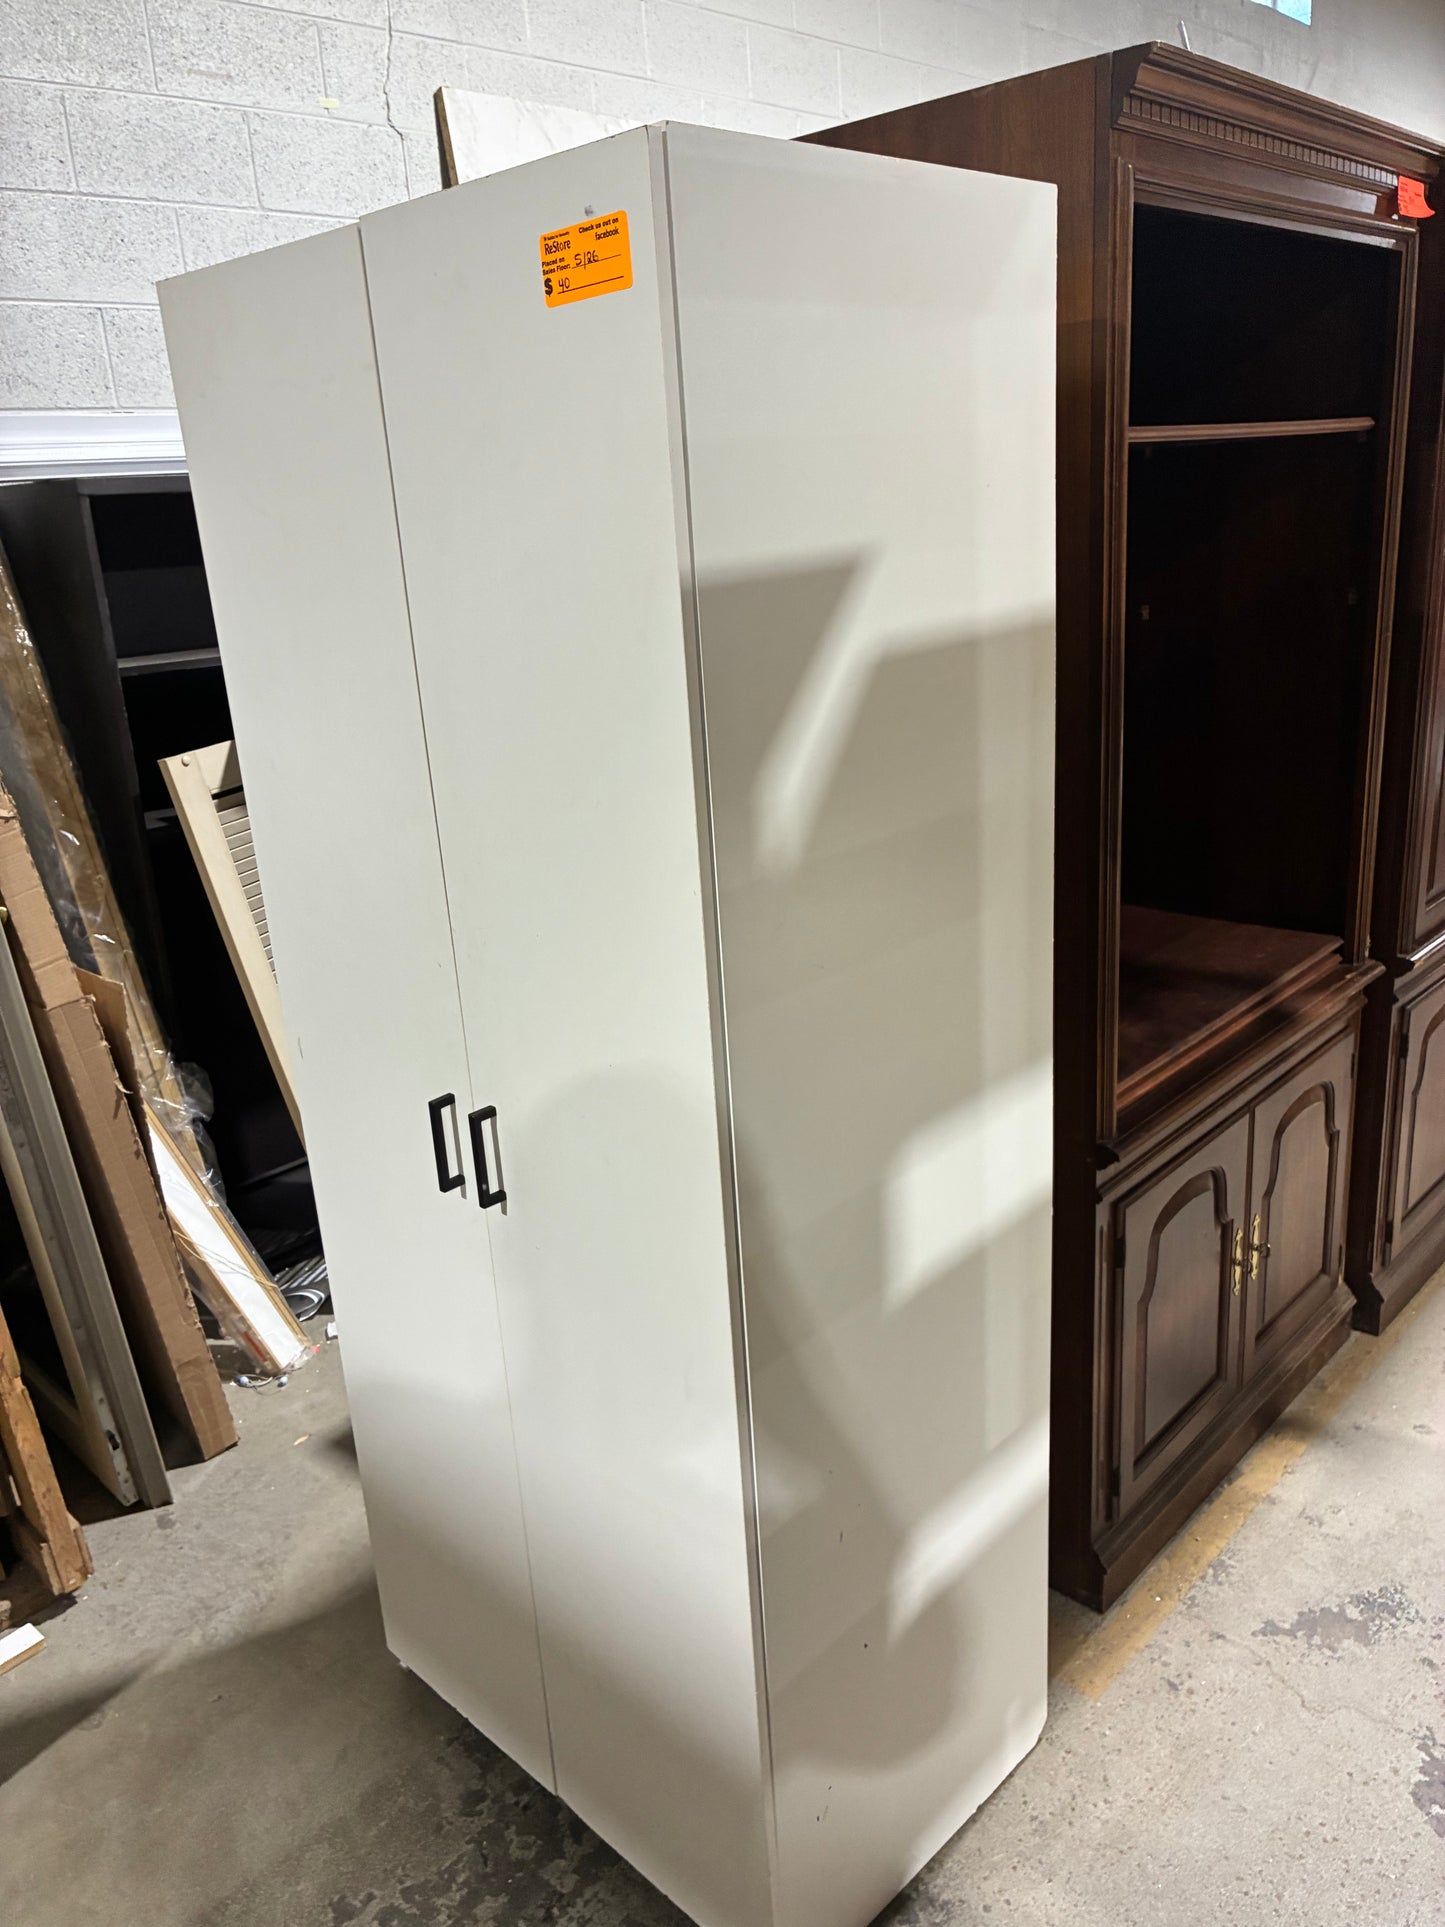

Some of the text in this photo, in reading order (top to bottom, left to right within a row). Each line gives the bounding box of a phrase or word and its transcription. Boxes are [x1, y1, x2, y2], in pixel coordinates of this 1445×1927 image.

[578, 224, 594, 233] Check
[595, 227, 619, 240] facebook
[544, 240, 571, 255] ReStore
[542, 259, 558, 267] Placed
[544, 277, 570, 297] $ 40
